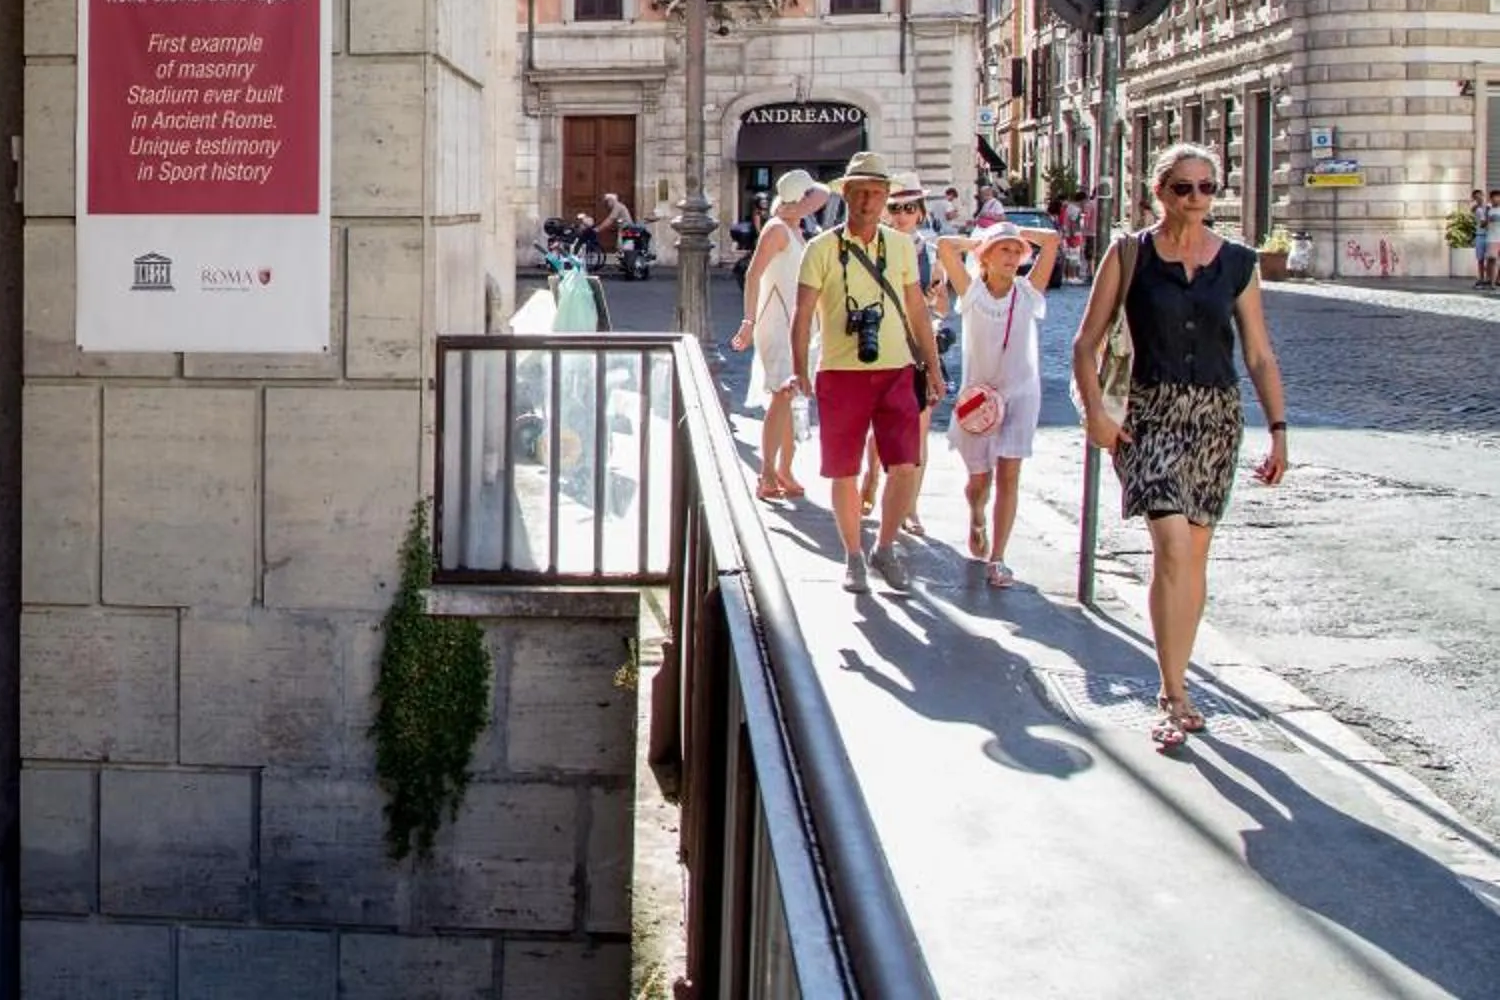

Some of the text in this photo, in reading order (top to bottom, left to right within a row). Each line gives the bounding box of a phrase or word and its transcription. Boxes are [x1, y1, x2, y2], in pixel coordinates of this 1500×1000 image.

[148, 32, 263, 56] First example
[155, 60, 256, 82] of masonry
[127, 83, 284, 104] Stadium ever built
[131, 109, 277, 130] in Ancient Rome.
[747, 107, 861, 123] ANDREANO
[129, 135, 282, 158] Unique testimony
[137, 160, 273, 184] in Sport history
[201, 269, 254, 284] ROMA
